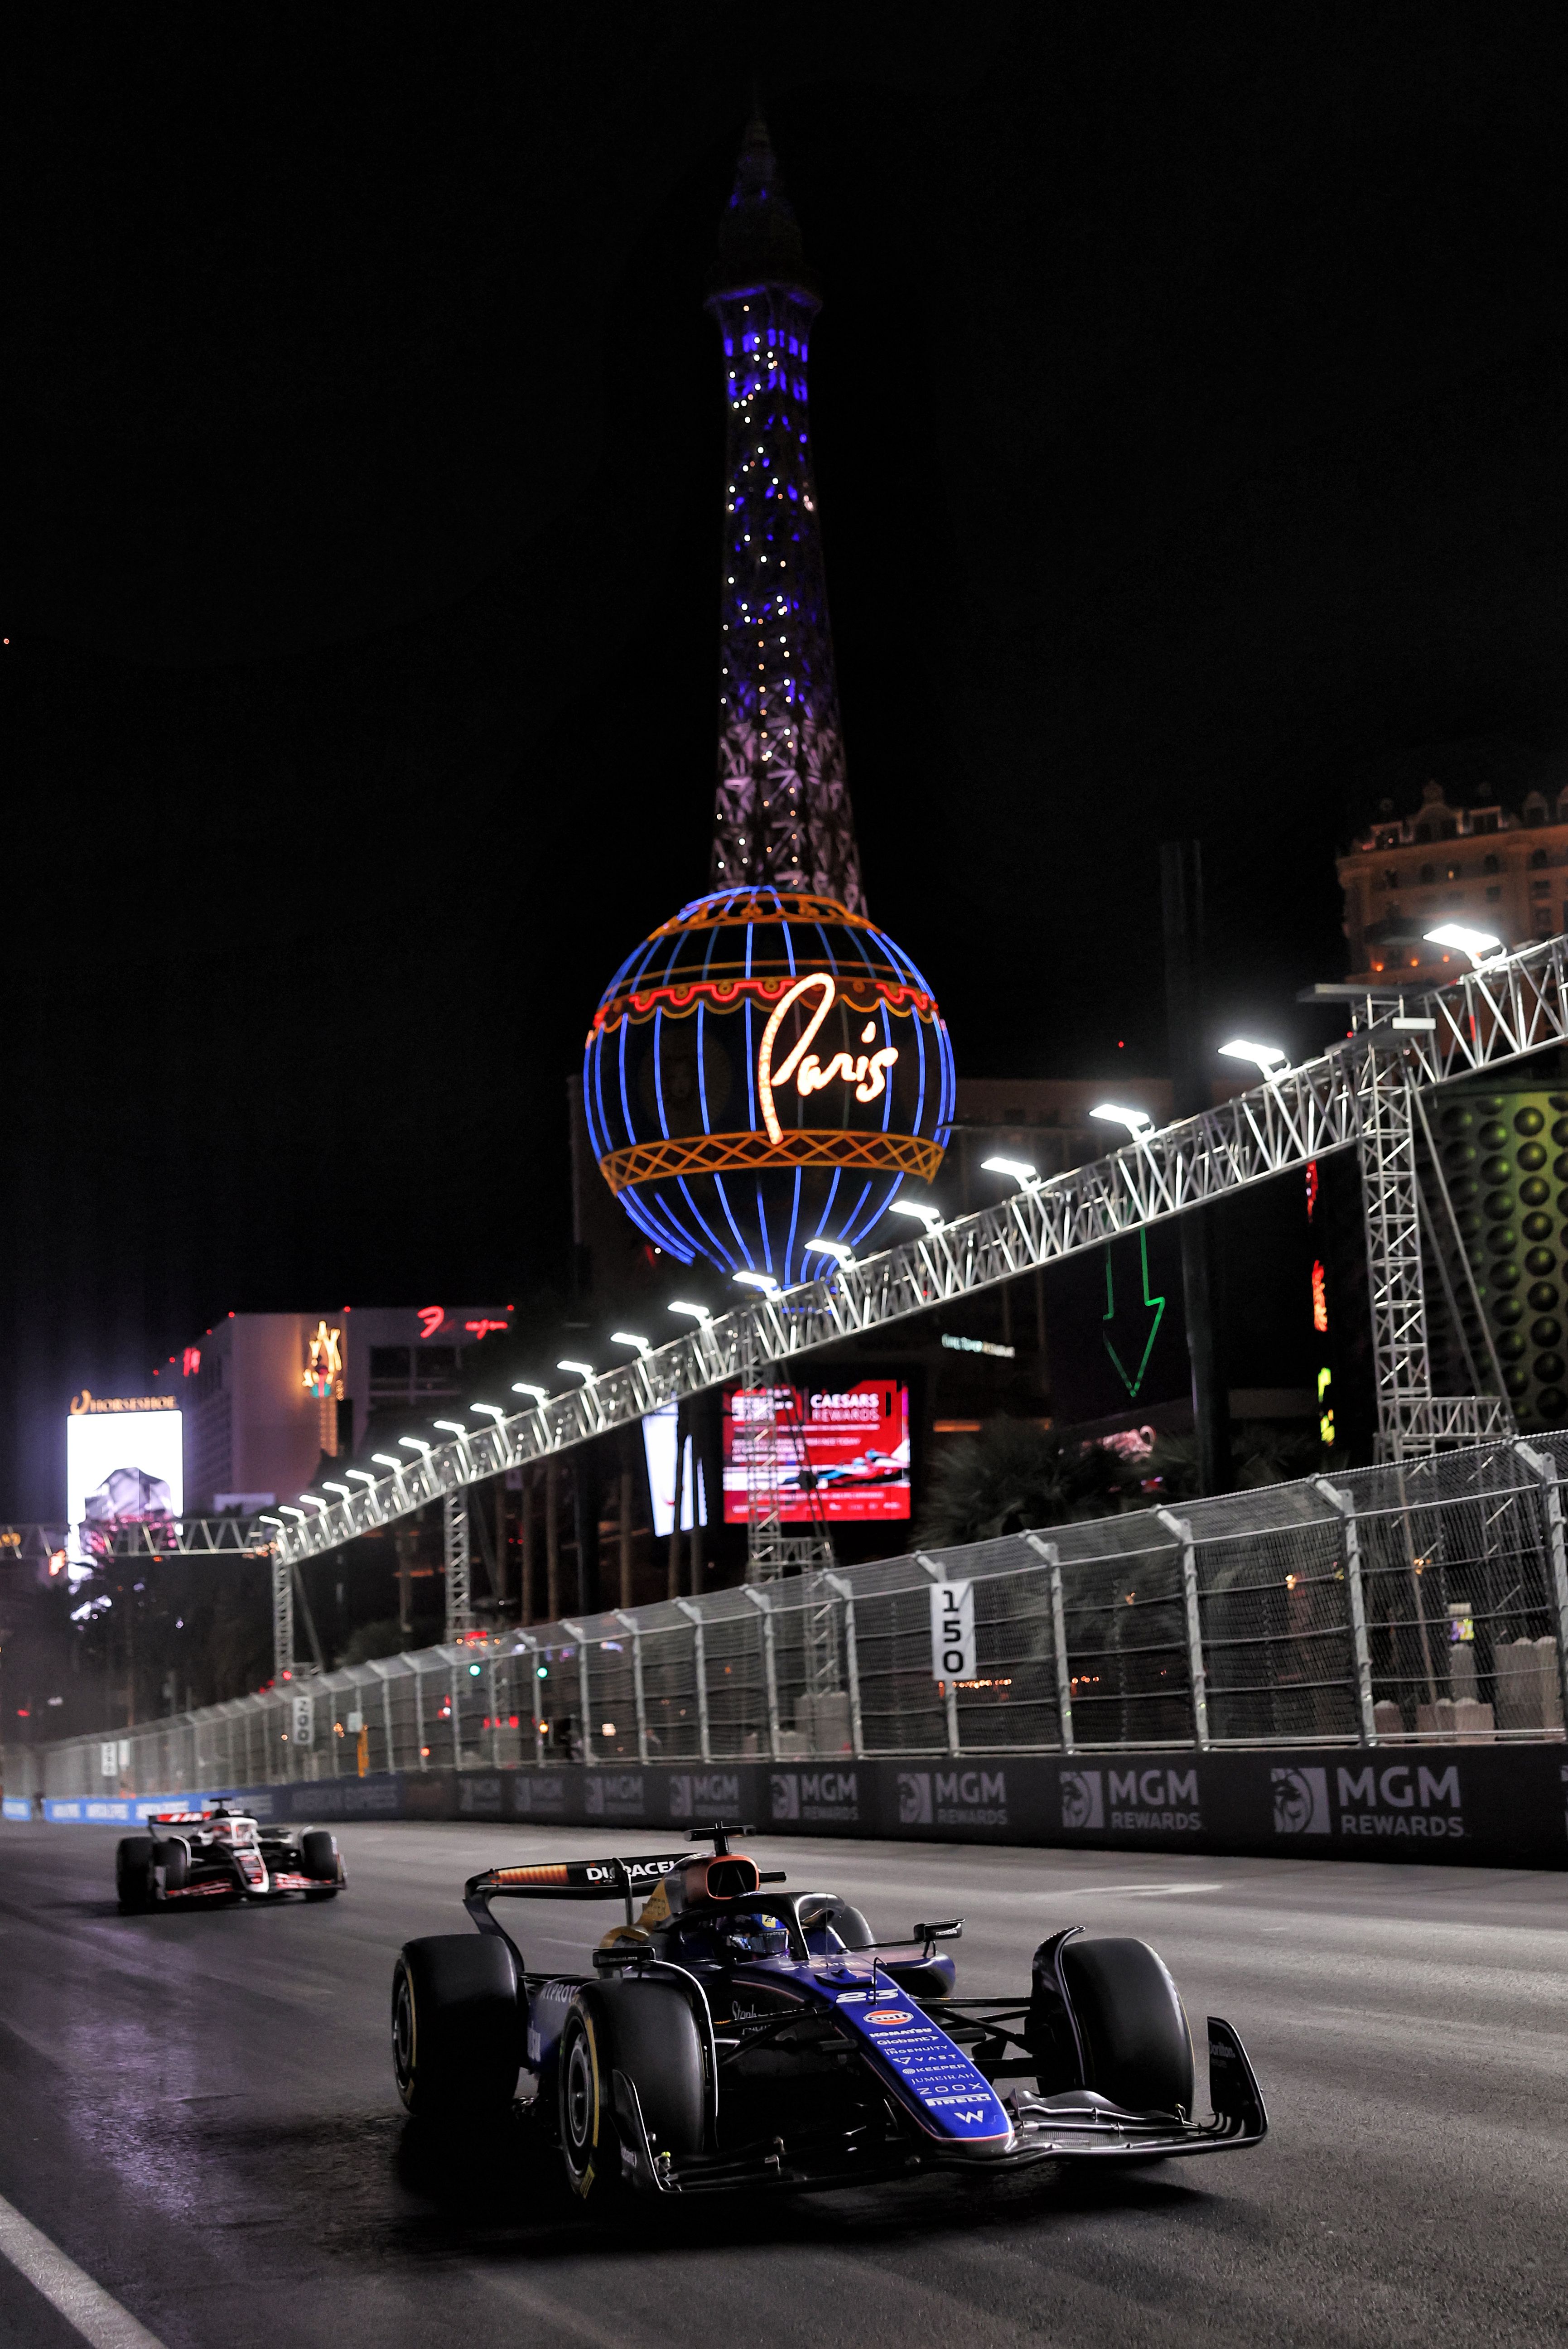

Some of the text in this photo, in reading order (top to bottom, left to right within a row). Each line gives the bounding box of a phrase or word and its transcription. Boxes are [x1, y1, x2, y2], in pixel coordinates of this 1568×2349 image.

[758, 973, 899, 1144] Paris
[810, 1393, 879, 1408] CAESARS
[812, 1408, 880, 1422] REWARDS
[942, 1590, 964, 1673] 150
[694, 1775, 739, 1801] MGM
[801, 1773, 858, 1802] MGM
[935, 1771, 1007, 1804] MGM
[1108, 1769, 1199, 1805] MGM
[1336, 1765, 1462, 1808] MGM
[1111, 1812, 1201, 1830] REWARDS
[1341, 1814, 1464, 1838] REWARDS
[836, 1989, 898, 2003] 23
[869, 2028, 932, 2038] KOMATSU
[877, 2036, 930, 2045] Globant
[886, 2045, 948, 2055] INGENUITY
[916, 2064, 967, 2073] KEEPER
[911, 2073, 975, 2085] JUMEIRAH
[917, 2082, 984, 2095] ZOOX
[924, 2093, 992, 2107] PIRELLI
